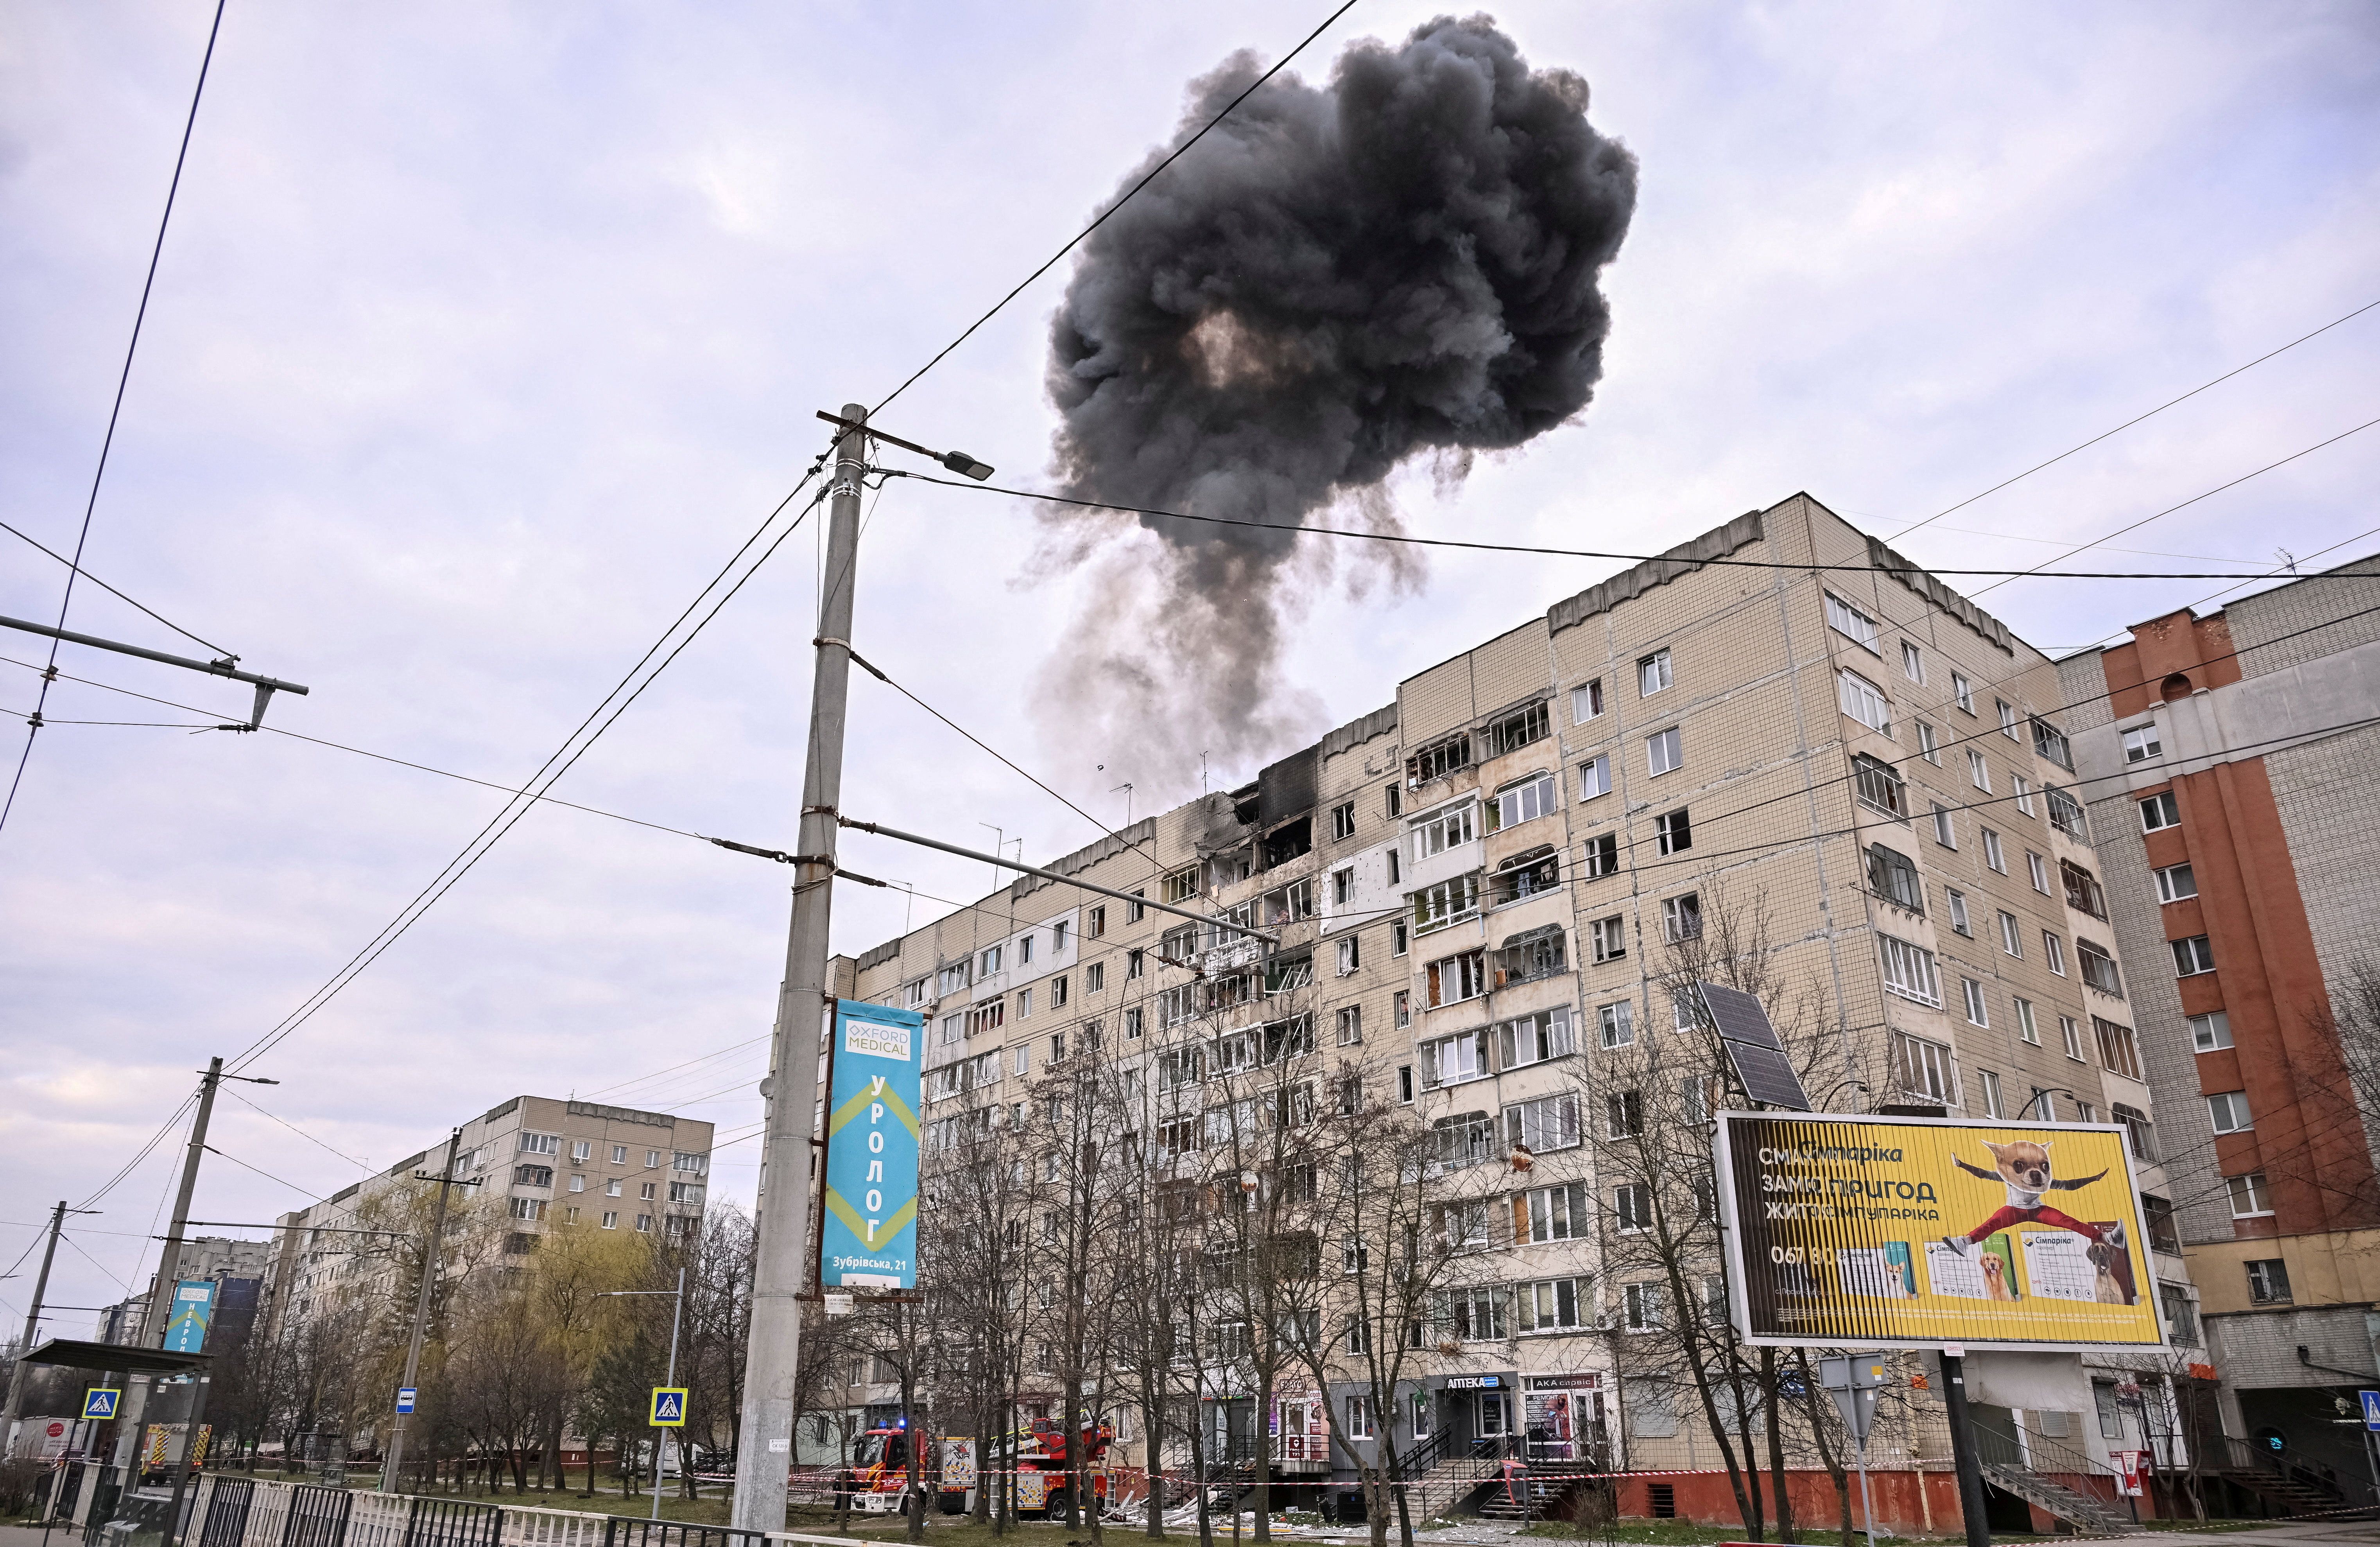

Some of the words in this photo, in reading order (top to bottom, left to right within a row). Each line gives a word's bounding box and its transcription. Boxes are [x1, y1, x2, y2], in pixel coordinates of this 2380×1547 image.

[849, 1025, 908, 1043] OXFORD
[849, 1036, 907, 1055] MEDICAL
[866, 1075, 886, 1242] УРОЛОГ
[833, 1256, 893, 1271] Зубрівська,
[894, 1260, 906, 1271] 21
[1771, 1246, 1803, 1264] 067
[1448, 1377, 1486, 1388] АПТЕКА
[1559, 1378, 1591, 1387] сервіс
